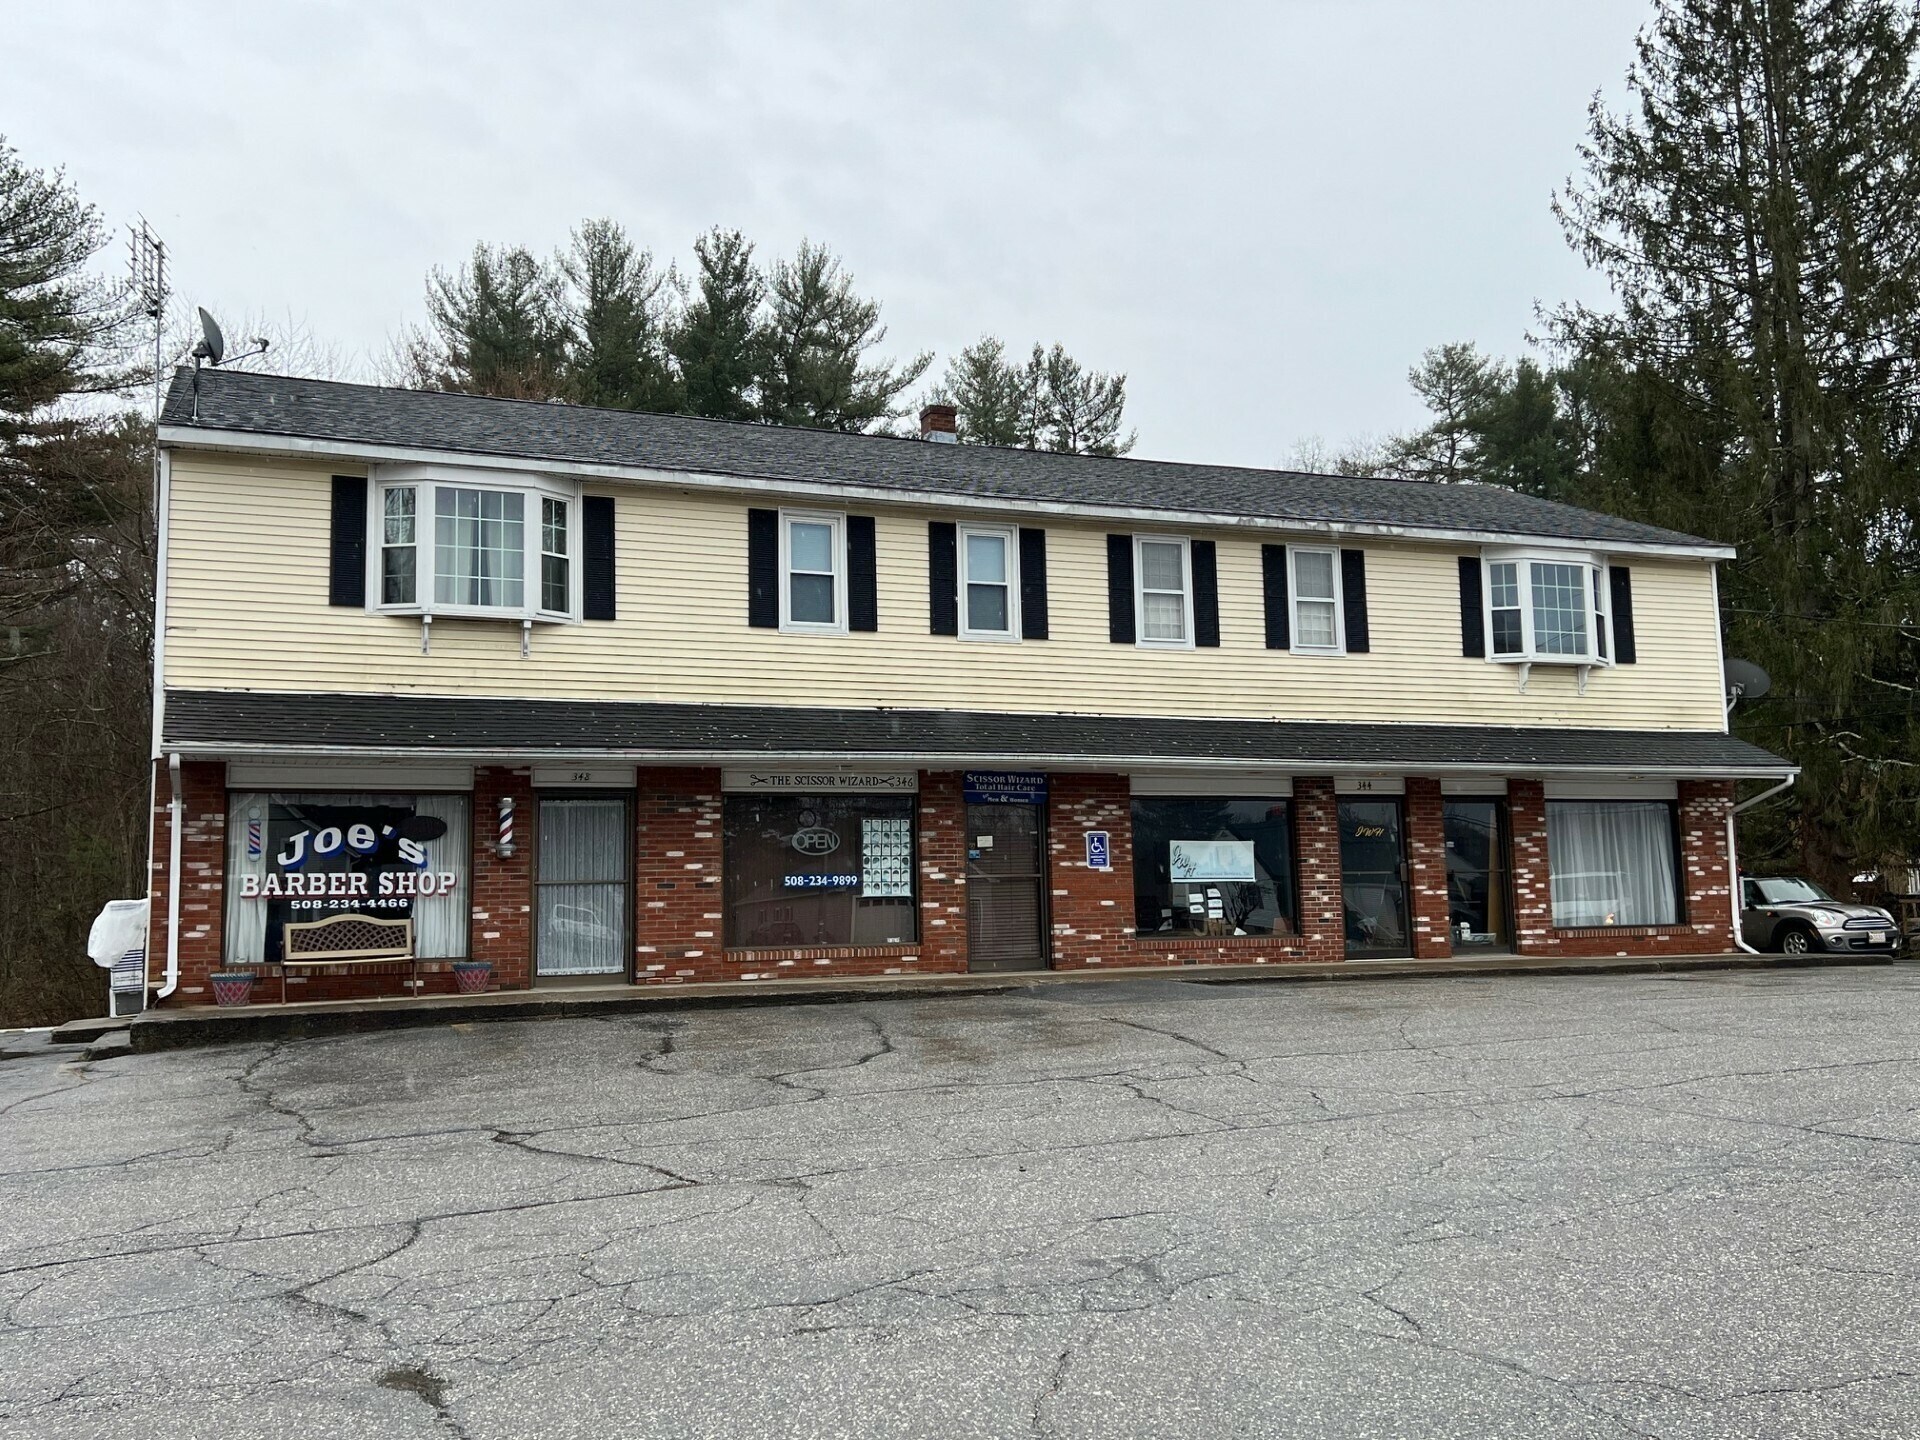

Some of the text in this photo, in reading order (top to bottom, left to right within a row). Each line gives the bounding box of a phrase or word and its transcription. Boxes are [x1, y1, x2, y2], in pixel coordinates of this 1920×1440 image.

[571, 773, 591, 781] 348
[770, 775, 879, 787] THE SCISSOR WIZARD
[967, 774, 1044, 785] SCISSOR WIZARD
[896, 778, 913, 788] 346
[1017, 784, 1036, 792] Care
[1357, 781, 1373, 791] 344
[1000, 794, 1009, 803] &
[277, 823, 427, 869] Joe's
[795, 834, 836, 849] OPEN
[240, 871, 457, 898] BARBER SHOP
[784, 875, 858, 887] 508-234-9899
[290, 898, 409, 910] 508-234-4466
